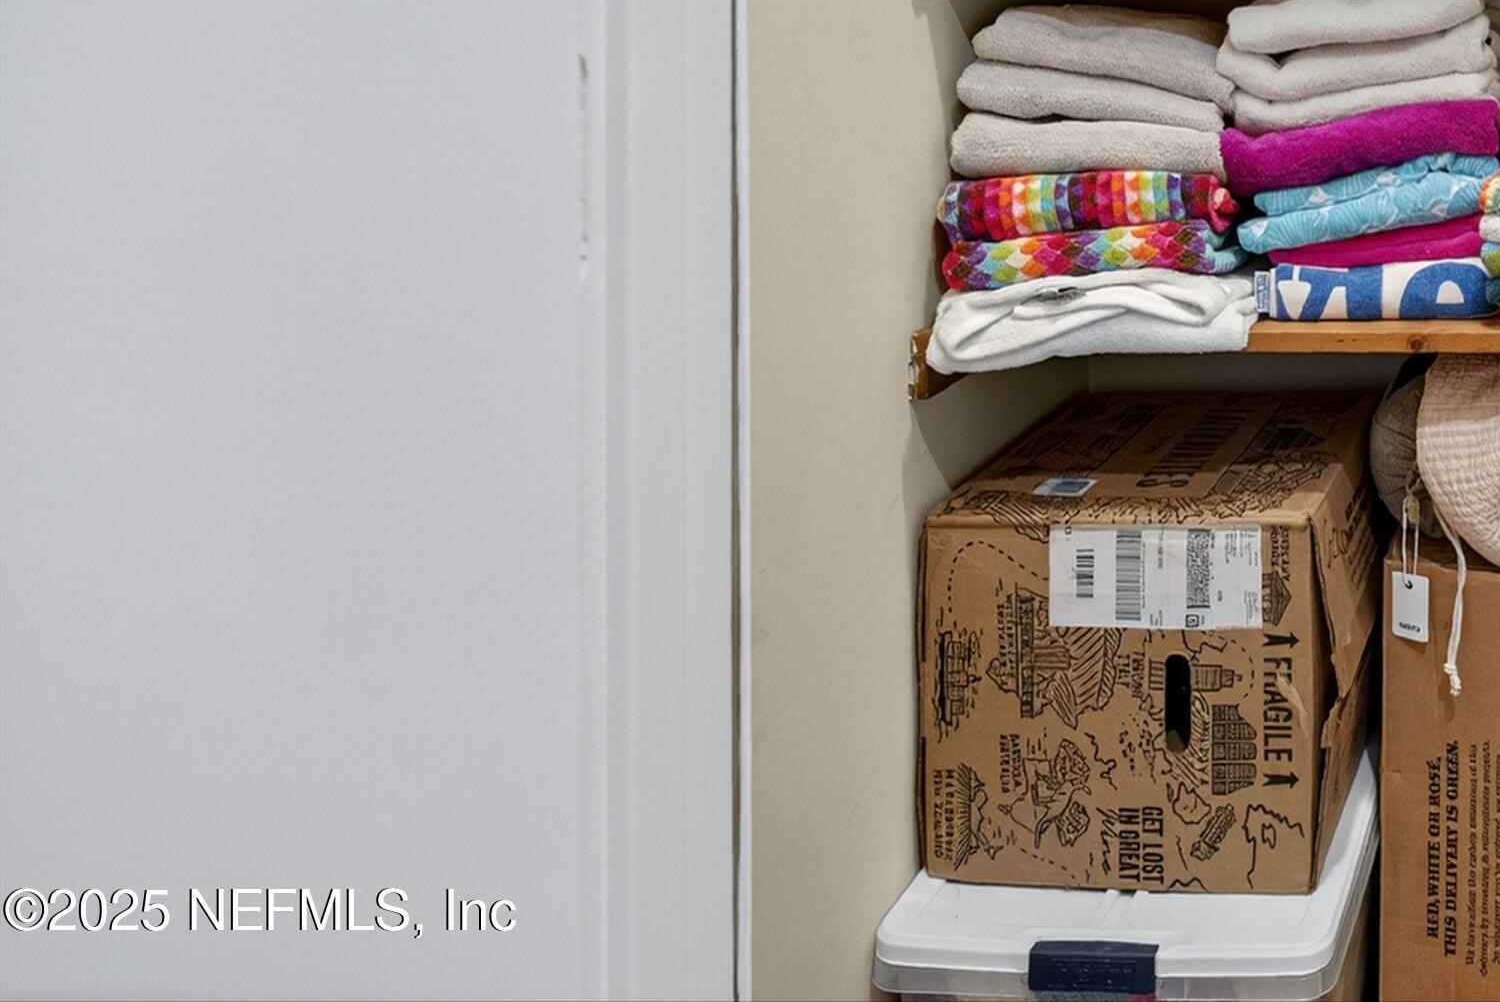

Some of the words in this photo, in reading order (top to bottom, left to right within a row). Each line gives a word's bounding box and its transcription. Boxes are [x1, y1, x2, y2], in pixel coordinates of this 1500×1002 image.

[1262, 657, 1293, 762] FRAGILE
[1119, 807, 1140, 825] IN
[1142, 806, 1164, 837] GET
[1427, 811, 1441, 837] OR
[1446, 806, 1459, 823] IS
[1119, 830, 1140, 882] GREAT
[1142, 842, 1164, 885] LOST
[1427, 841, 1440, 897] WHITE
[1445, 826, 1459, 911] DELIVERY
[1427, 900, 1441, 938] RED,
[1444, 915, 1457, 957] THIS
